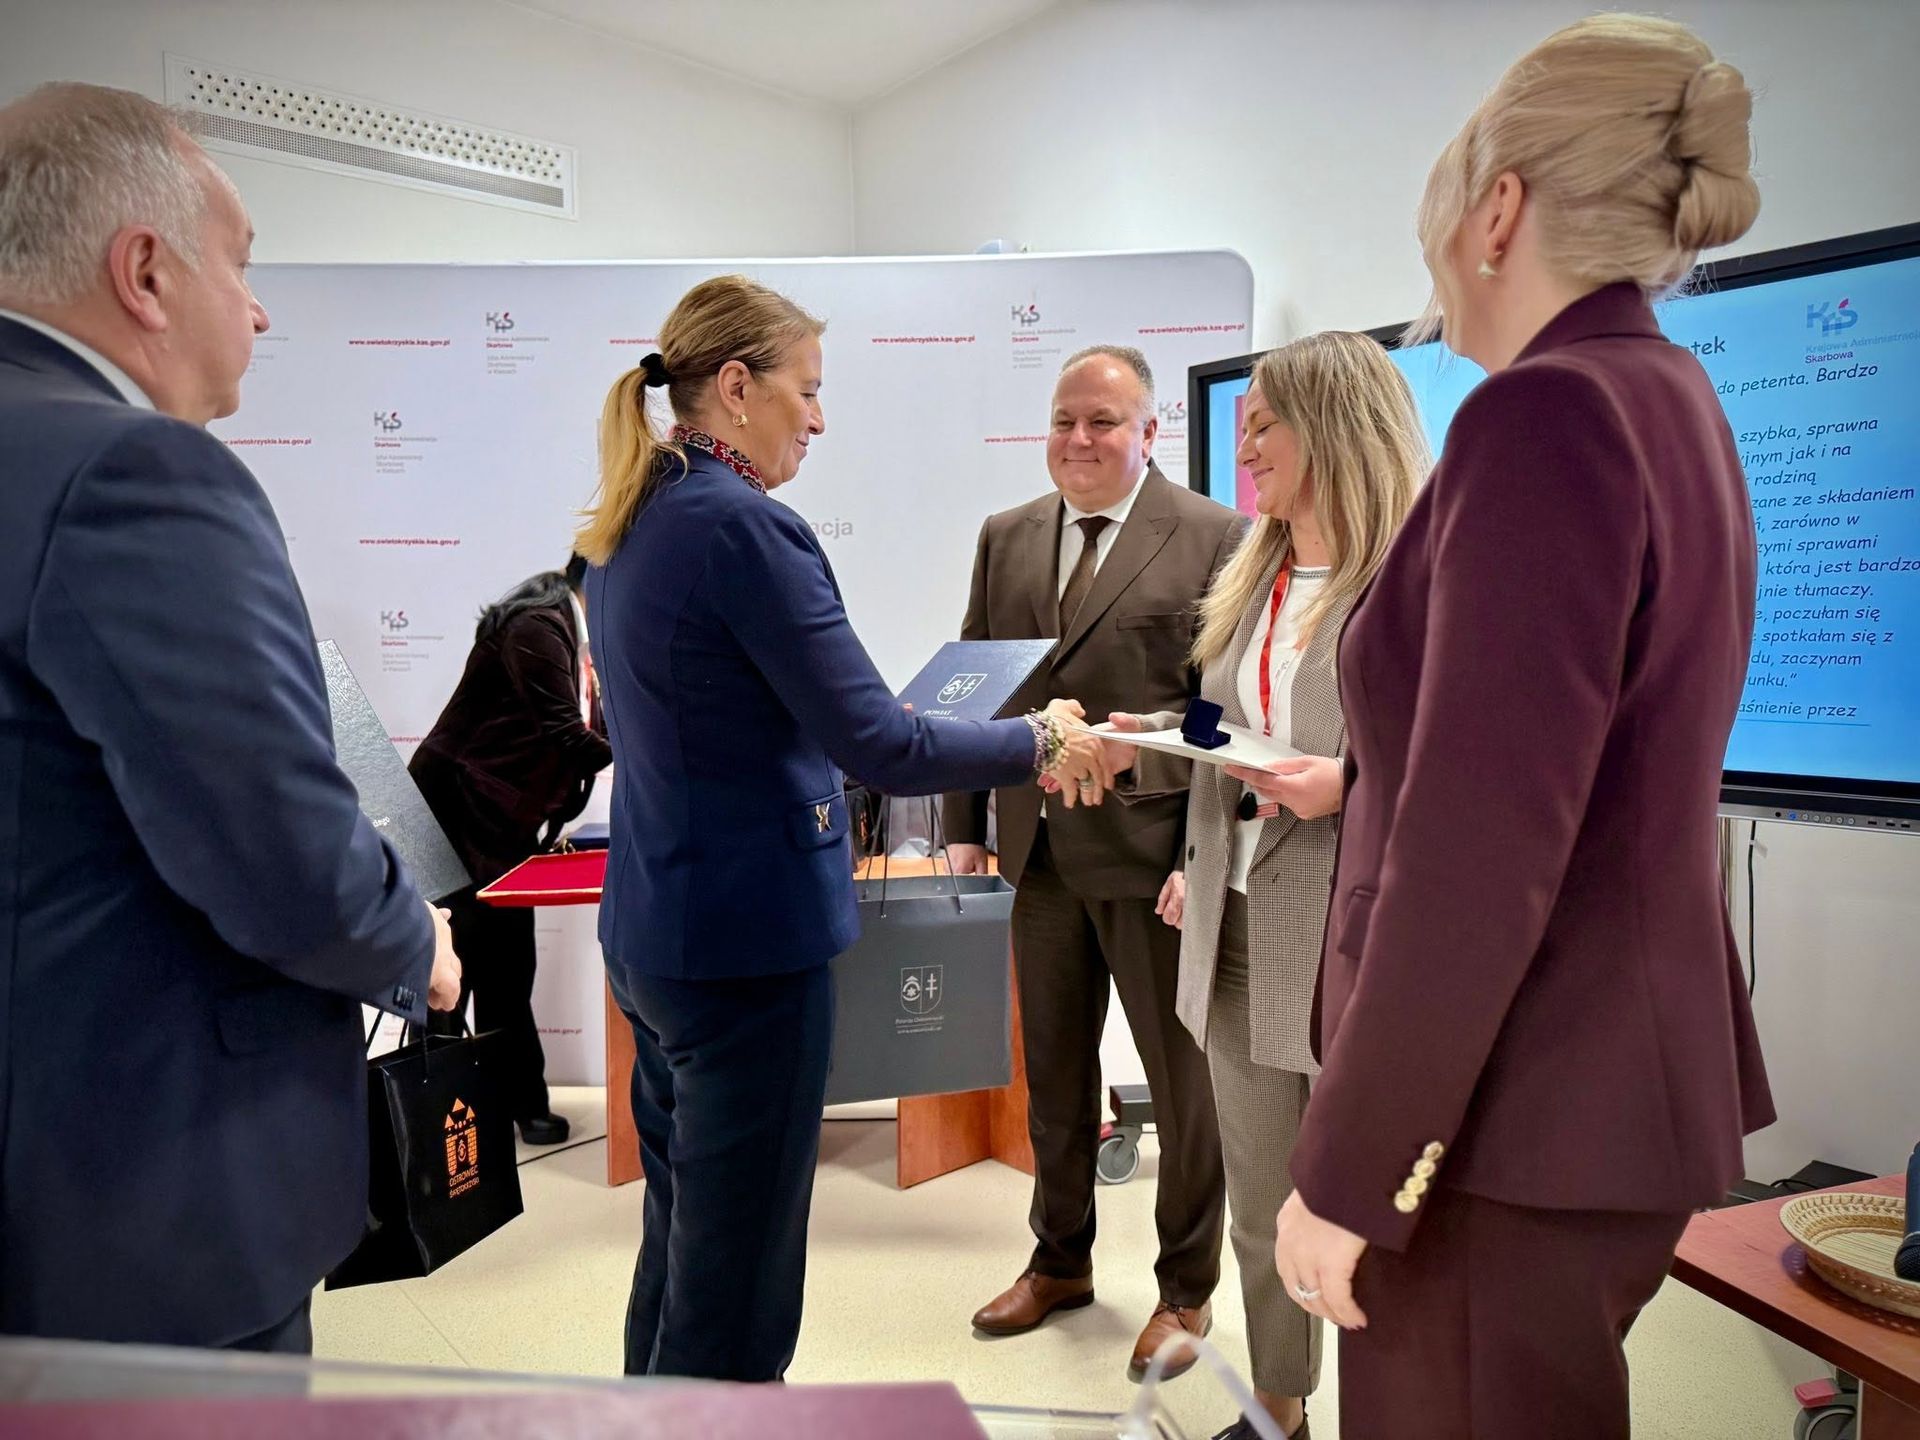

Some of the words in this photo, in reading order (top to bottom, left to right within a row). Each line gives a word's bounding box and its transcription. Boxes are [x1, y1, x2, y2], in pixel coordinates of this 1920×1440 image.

[1689, 335, 1726, 357] tek
[1804, 350, 1854, 364] Skarbowa
[1716, 380, 1736, 395] do
[1740, 373, 1809, 397] petenta.
[1816, 363, 1879, 383] Bardzo
[1739, 424, 1802, 445] szybka,
[1806, 418, 1879, 440] sprawna
[1785, 444, 1816, 464] jak
[1821, 443, 1827, 457] i
[1831, 444, 1851, 457] na
[1754, 469, 1817, 487] rodziną
[1792, 494, 1812, 506] ze
[1817, 486, 1915, 505] składaniem
[1771, 512, 1840, 531] zarówno
[1847, 515, 1860, 526] w
[1796, 534, 1879, 555] sprawami
[1765, 559, 1811, 575] która
[1813, 559, 1853, 578] jest
[1858, 556, 1920, 573] bardzo
[1794, 582, 1874, 600] tłumaczy.
[1772, 605, 1849, 624] poczułam
[1854, 605, 1881, 623] się
[1760, 627, 1845, 647] spotkałam
[1851, 628, 1877, 646] się
[1882, 632, 1894, 643] z
[1780, 653, 1862, 669] zaczynam
[1806, 704, 1858, 720] przez
